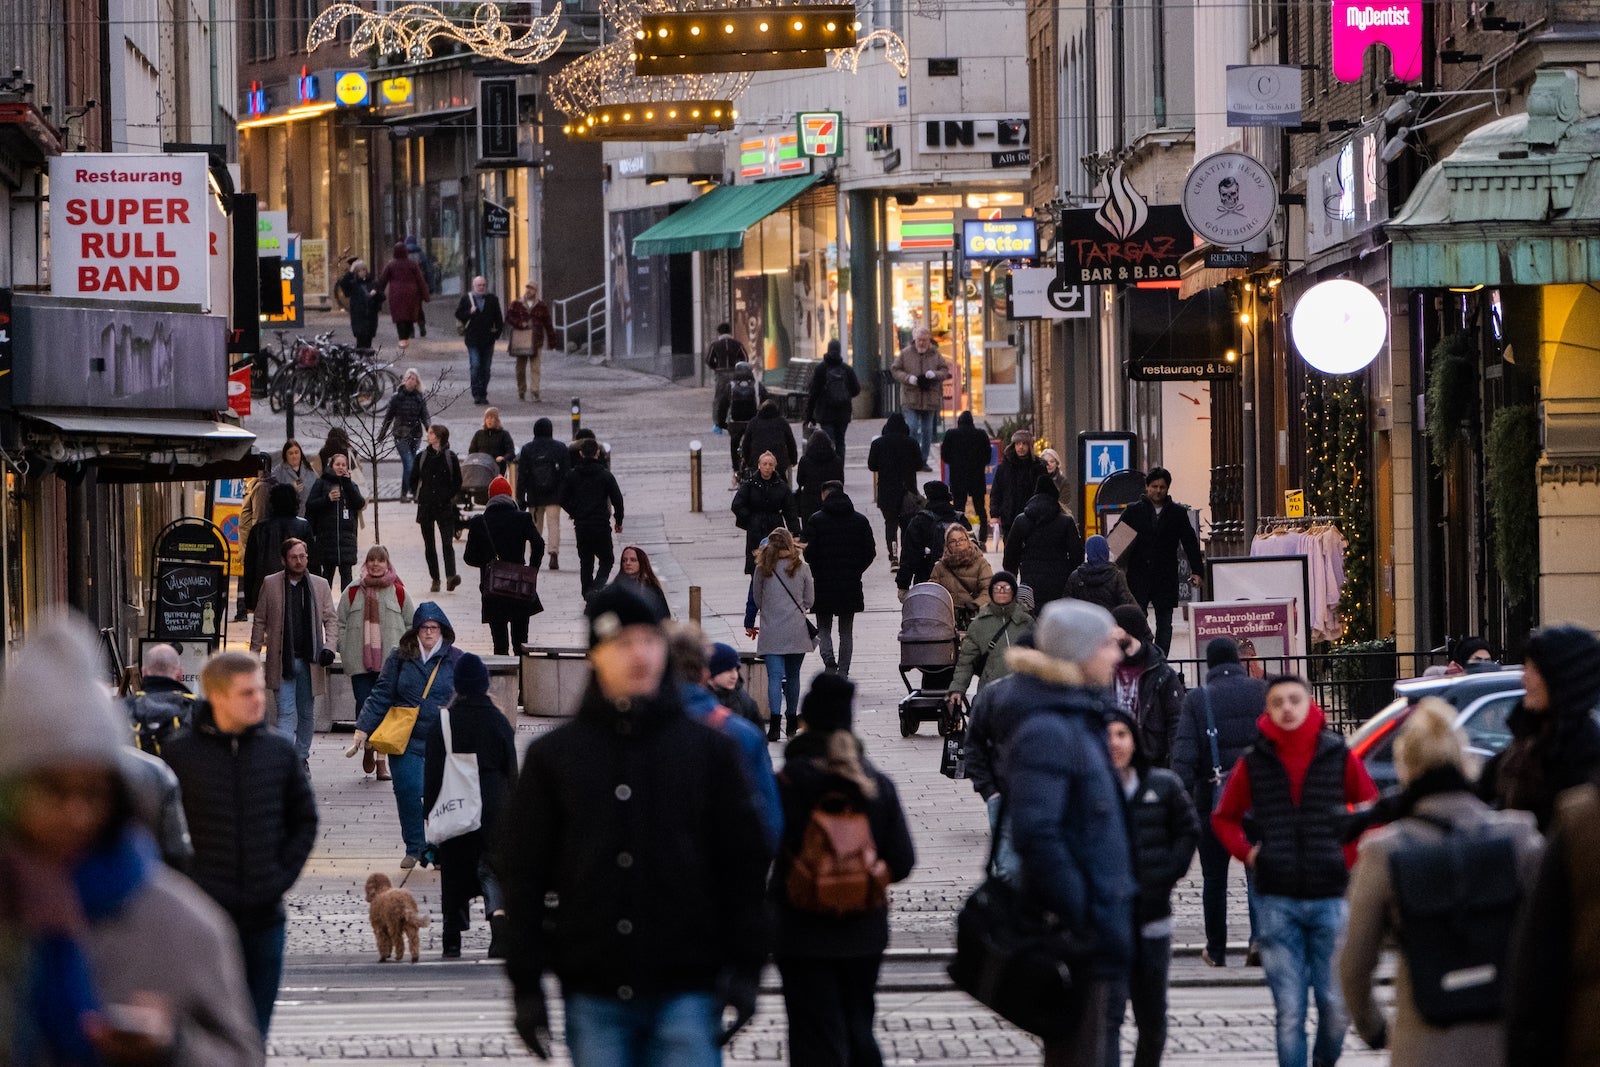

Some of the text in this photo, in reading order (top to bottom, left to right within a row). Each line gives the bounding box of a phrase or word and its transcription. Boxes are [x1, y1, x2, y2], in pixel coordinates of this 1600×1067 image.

[1347, 6, 1410, 31] MyDentist
[1257, 75, 1271, 95] C
[999, 153, 1016, 164] Allt
[75, 169, 183, 186] Restaurang
[1193, 161, 1234, 195] CREATIVE
[65, 198, 191, 226] SUPER
[487, 214, 507, 225] Drop
[1204, 218, 1260, 237] GÖTEBORG
[81, 231, 177, 259] RULL
[1070, 236, 1182, 267] TARGAZ
[1210, 253, 1249, 262] REDKEN
[78, 265, 180, 293] BAND
[1081, 267, 1112, 281] BAR
[1118, 265, 1129, 280] &
[1142, 364, 1205, 376] restaurang
[1206, 363, 1215, 374] &
[166, 574, 212, 592] VÄLKOMMEN
[1204, 611, 1276, 625] Tandproblem?
[1198, 623, 1283, 636] Dental problems?
